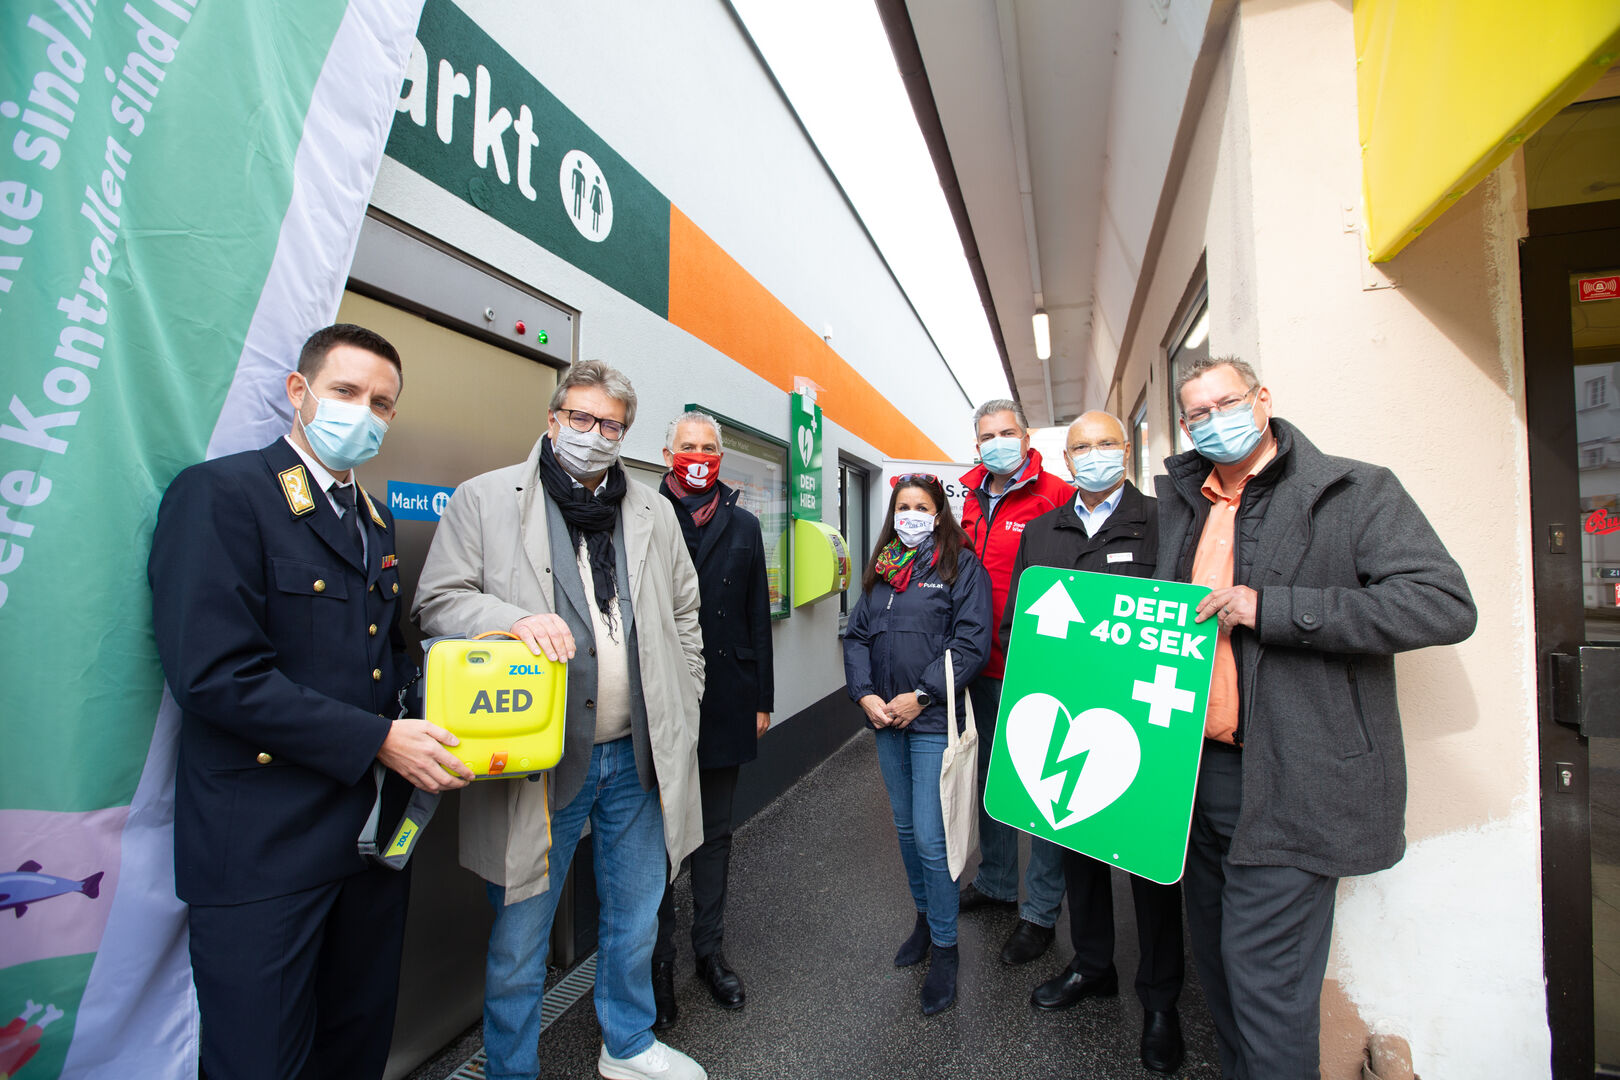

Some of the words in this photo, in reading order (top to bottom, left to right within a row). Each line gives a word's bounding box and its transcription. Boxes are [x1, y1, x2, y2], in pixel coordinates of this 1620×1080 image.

[0, 14, 87, 171] sind
[0, 135, 133, 455] Kontrollen
[104, 2, 181, 137] sind
[800, 473, 815, 491] DEFI
[391, 491, 429, 511] Markt
[800, 492, 815, 511] HIER
[1112, 593, 1189, 627] DEFI
[1089, 619, 1132, 646] 40
[1137, 626, 1208, 660] SEK
[508, 664, 542, 676] ZOLL
[468, 688, 534, 715] AED
[396, 828, 412, 849] ZOLL
